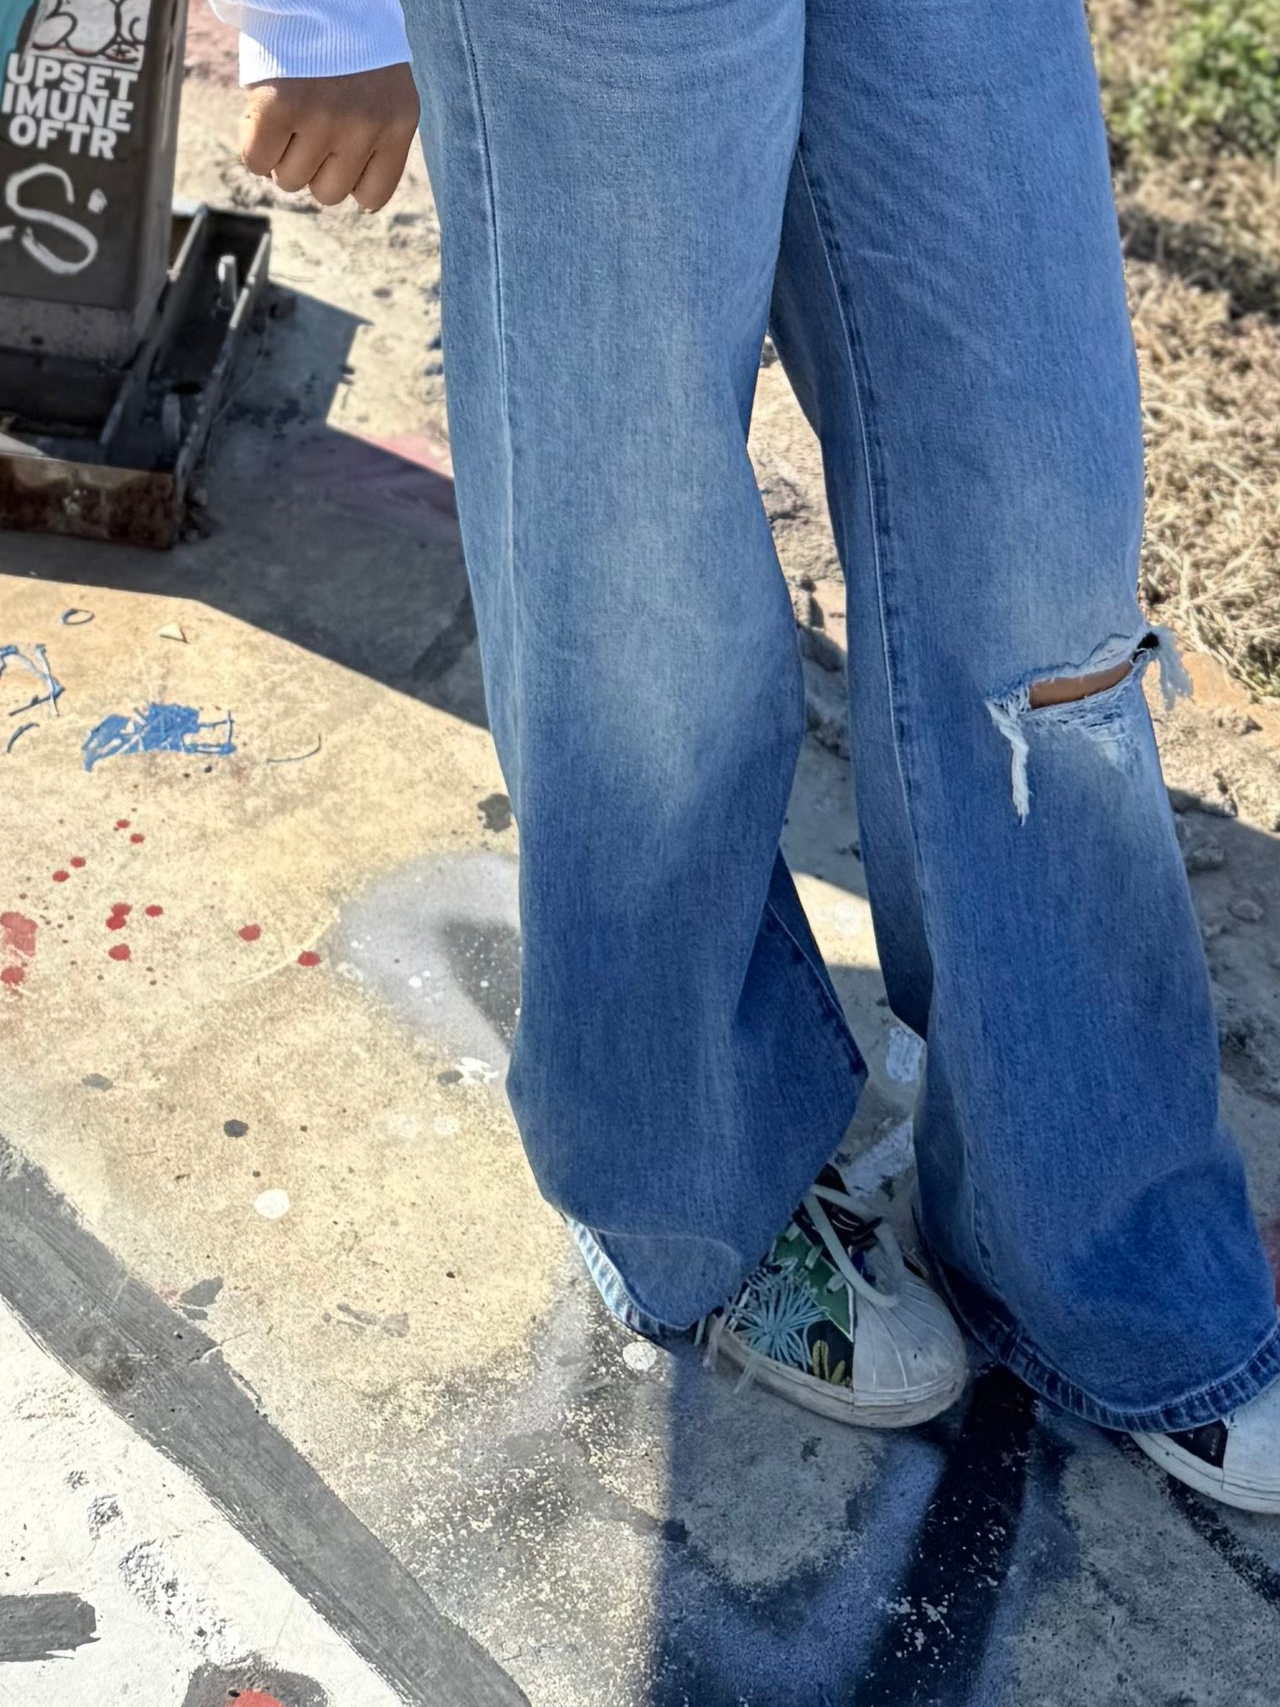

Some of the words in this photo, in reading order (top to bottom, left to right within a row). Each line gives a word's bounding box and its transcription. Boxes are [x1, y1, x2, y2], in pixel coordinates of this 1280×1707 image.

[7, 53, 138, 100] UPSET
[1, 84, 133, 133] IMUNE
[9, 115, 117, 159] OFTR
